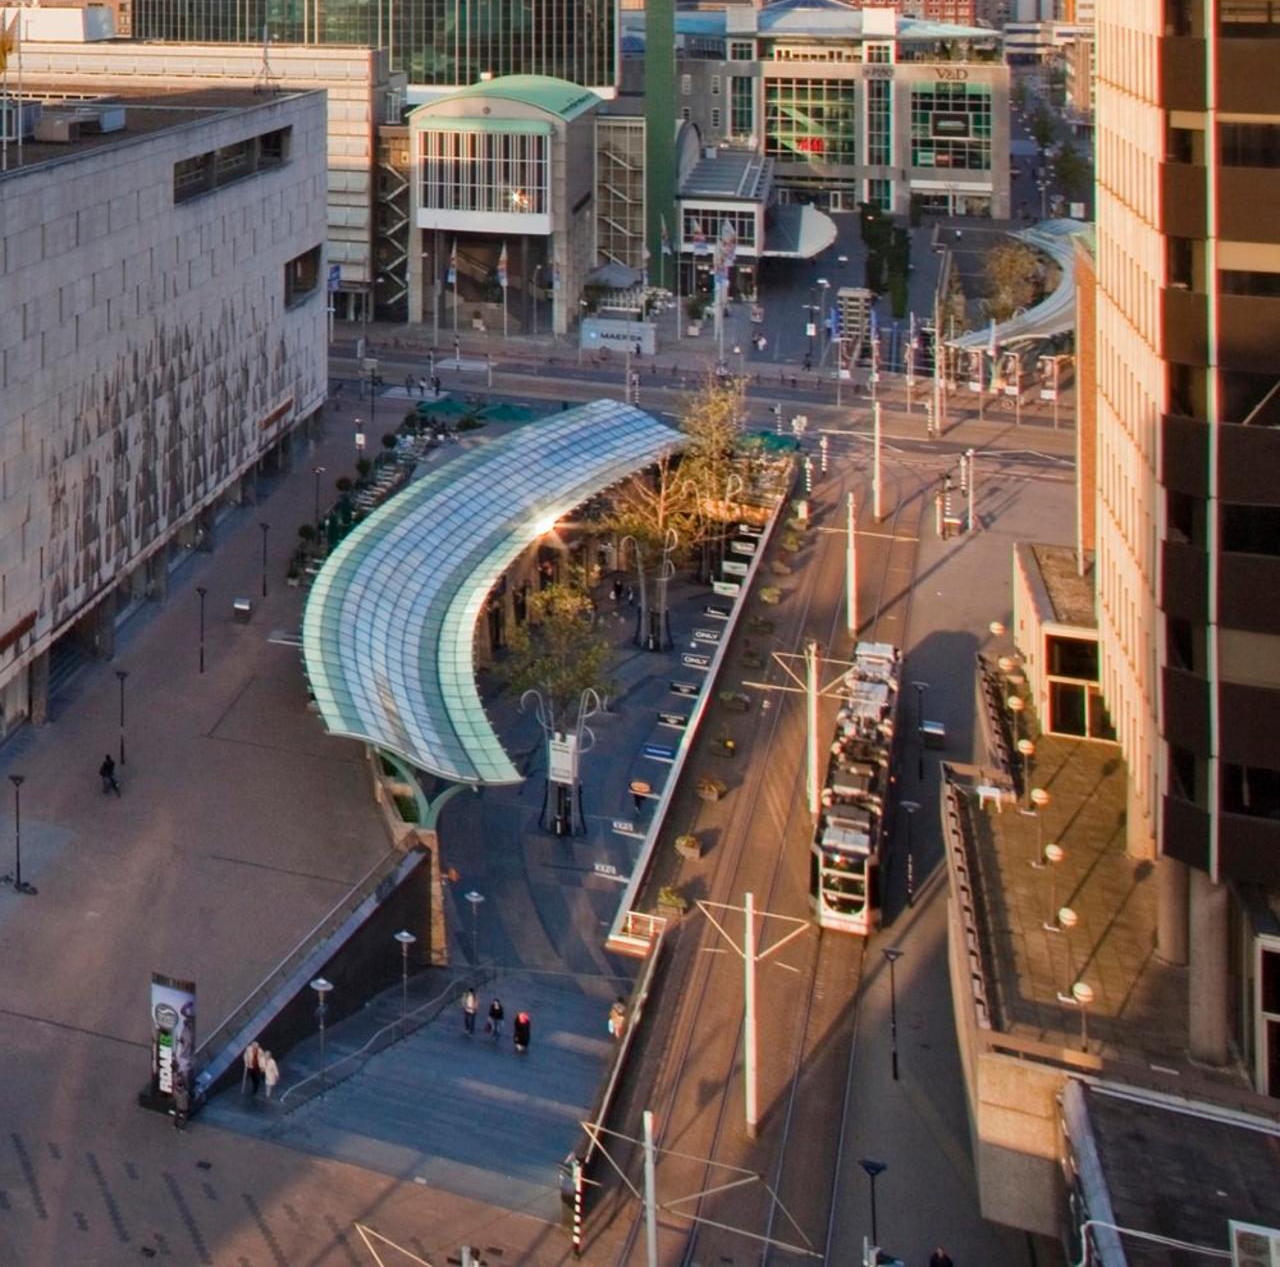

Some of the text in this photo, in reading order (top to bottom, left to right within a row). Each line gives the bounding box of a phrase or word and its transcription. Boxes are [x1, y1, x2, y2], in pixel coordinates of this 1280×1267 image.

[935, 68, 969, 80] V&D
[695, 630, 719, 639] ONLY
[684, 655, 708, 665] ONLY
